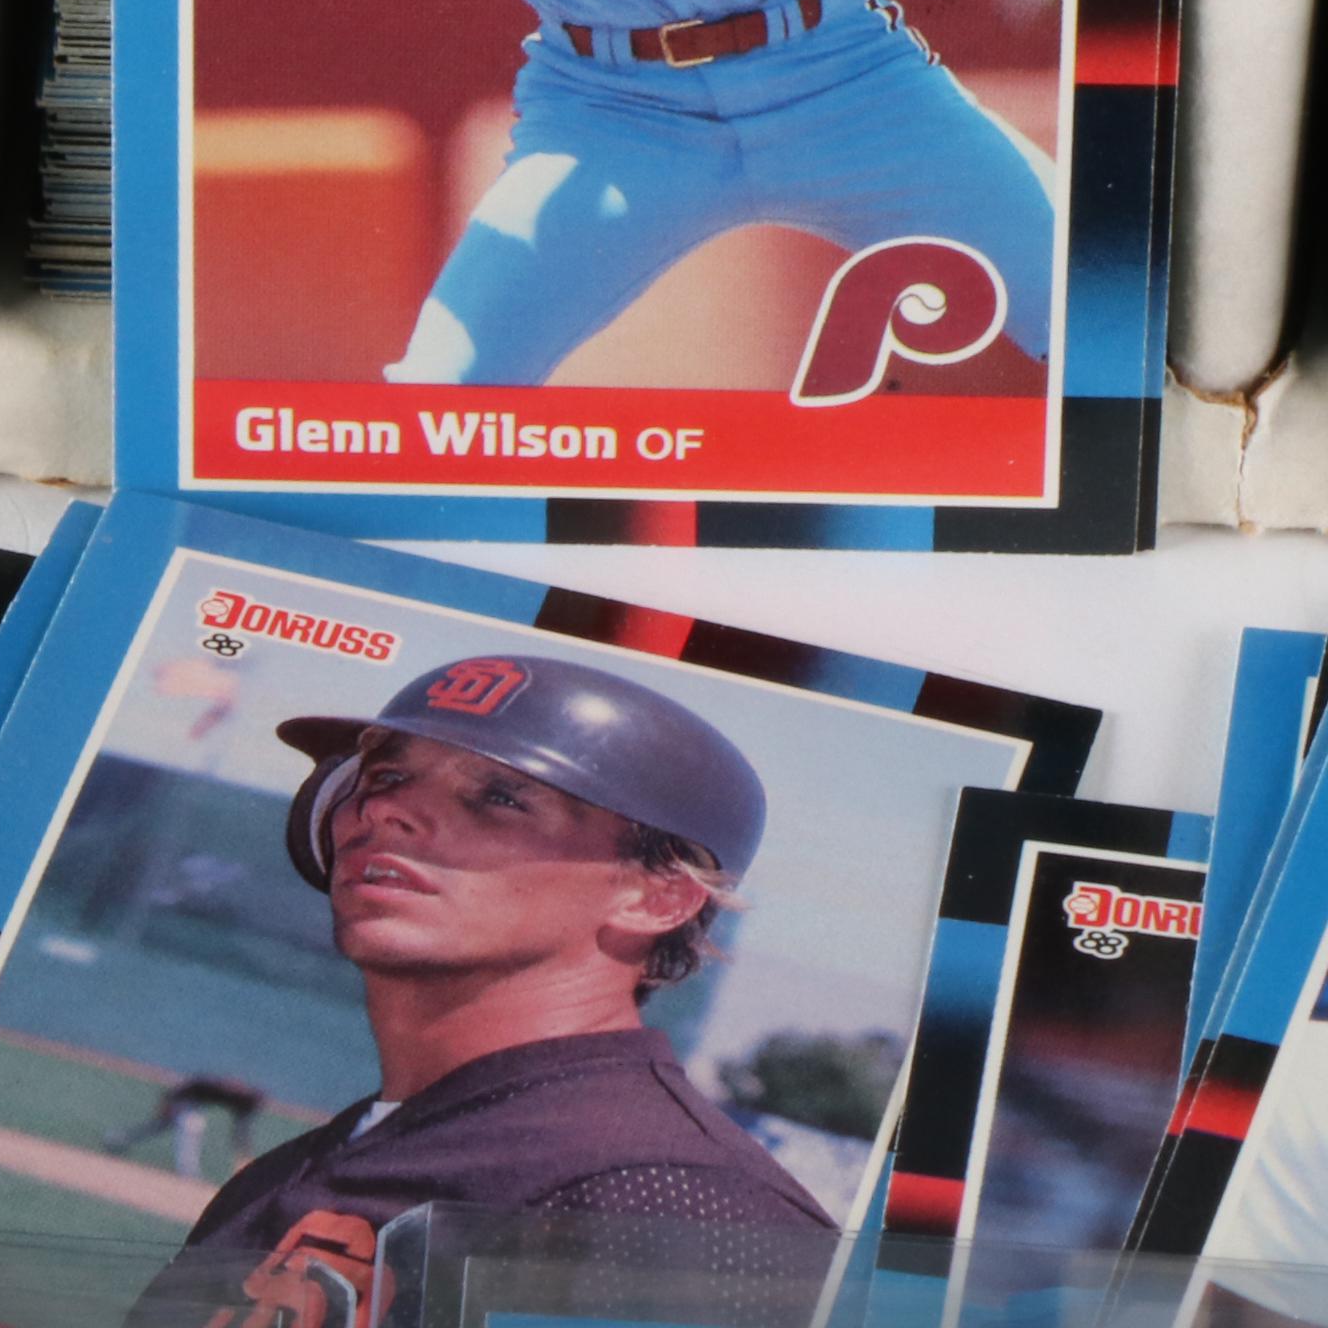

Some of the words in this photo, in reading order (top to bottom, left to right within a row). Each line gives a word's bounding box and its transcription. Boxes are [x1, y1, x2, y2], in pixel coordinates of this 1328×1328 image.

[235, 407, 400, 455] Glenn
[417, 411, 617, 460] Wilson
[636, 427, 704, 461] OF
[201, 590, 395, 661] DONRUSS
